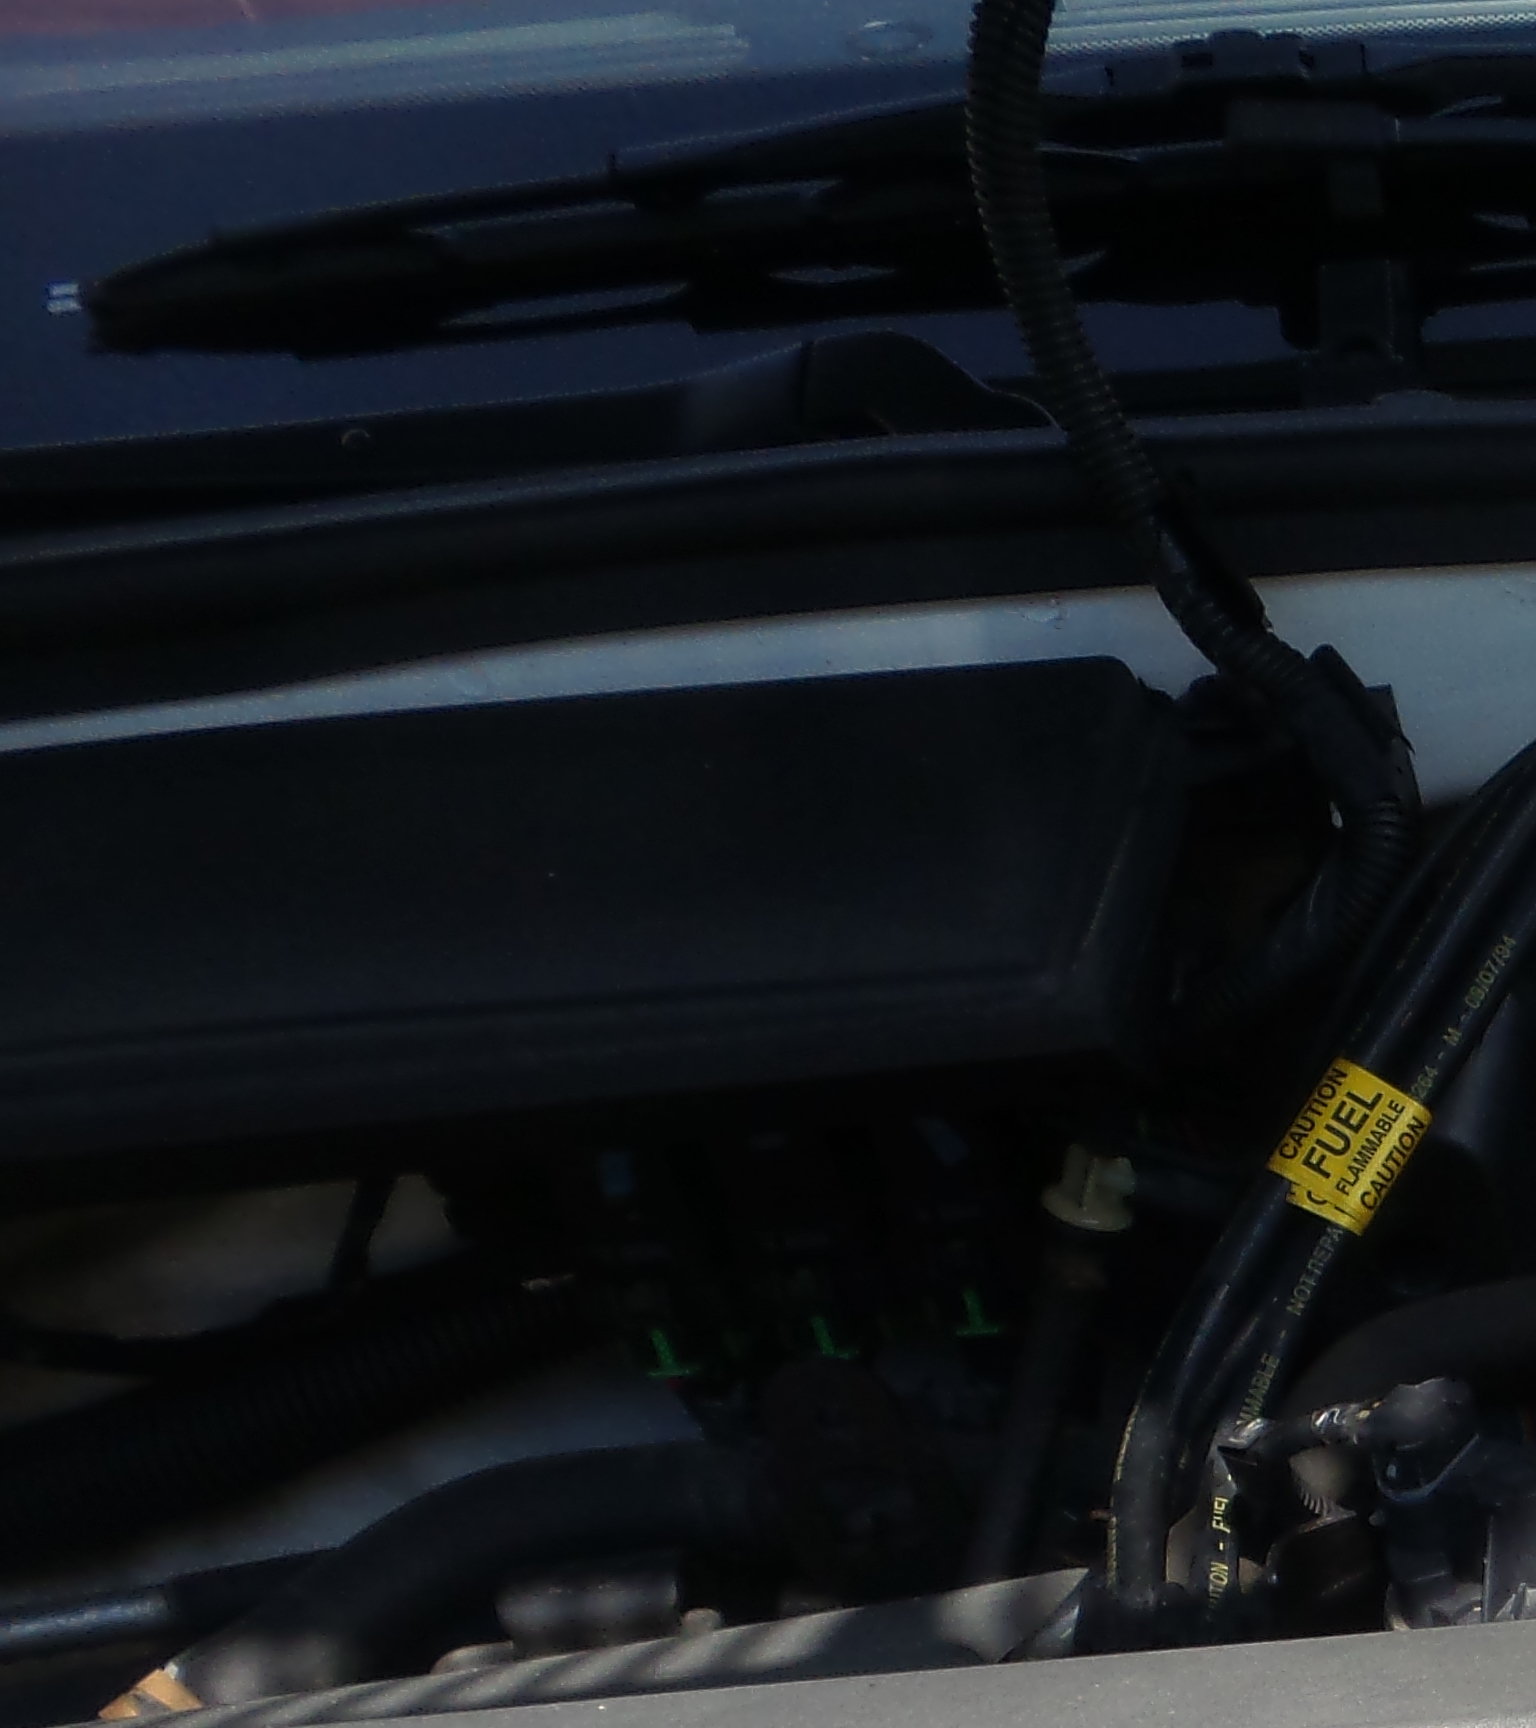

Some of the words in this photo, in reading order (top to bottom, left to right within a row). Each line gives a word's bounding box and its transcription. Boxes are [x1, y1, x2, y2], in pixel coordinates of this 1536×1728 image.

[1278, 1067, 1348, 1160] CAUTION
[1411, 1064, 1439, 1099] 264
[1301, 1090, 1384, 1180] FUEL
[1335, 1099, 1406, 1197] FLAMMABLE
[1360, 1115, 1425, 1211] CAUTION
[1285, 1273, 1318, 1318] NOT
